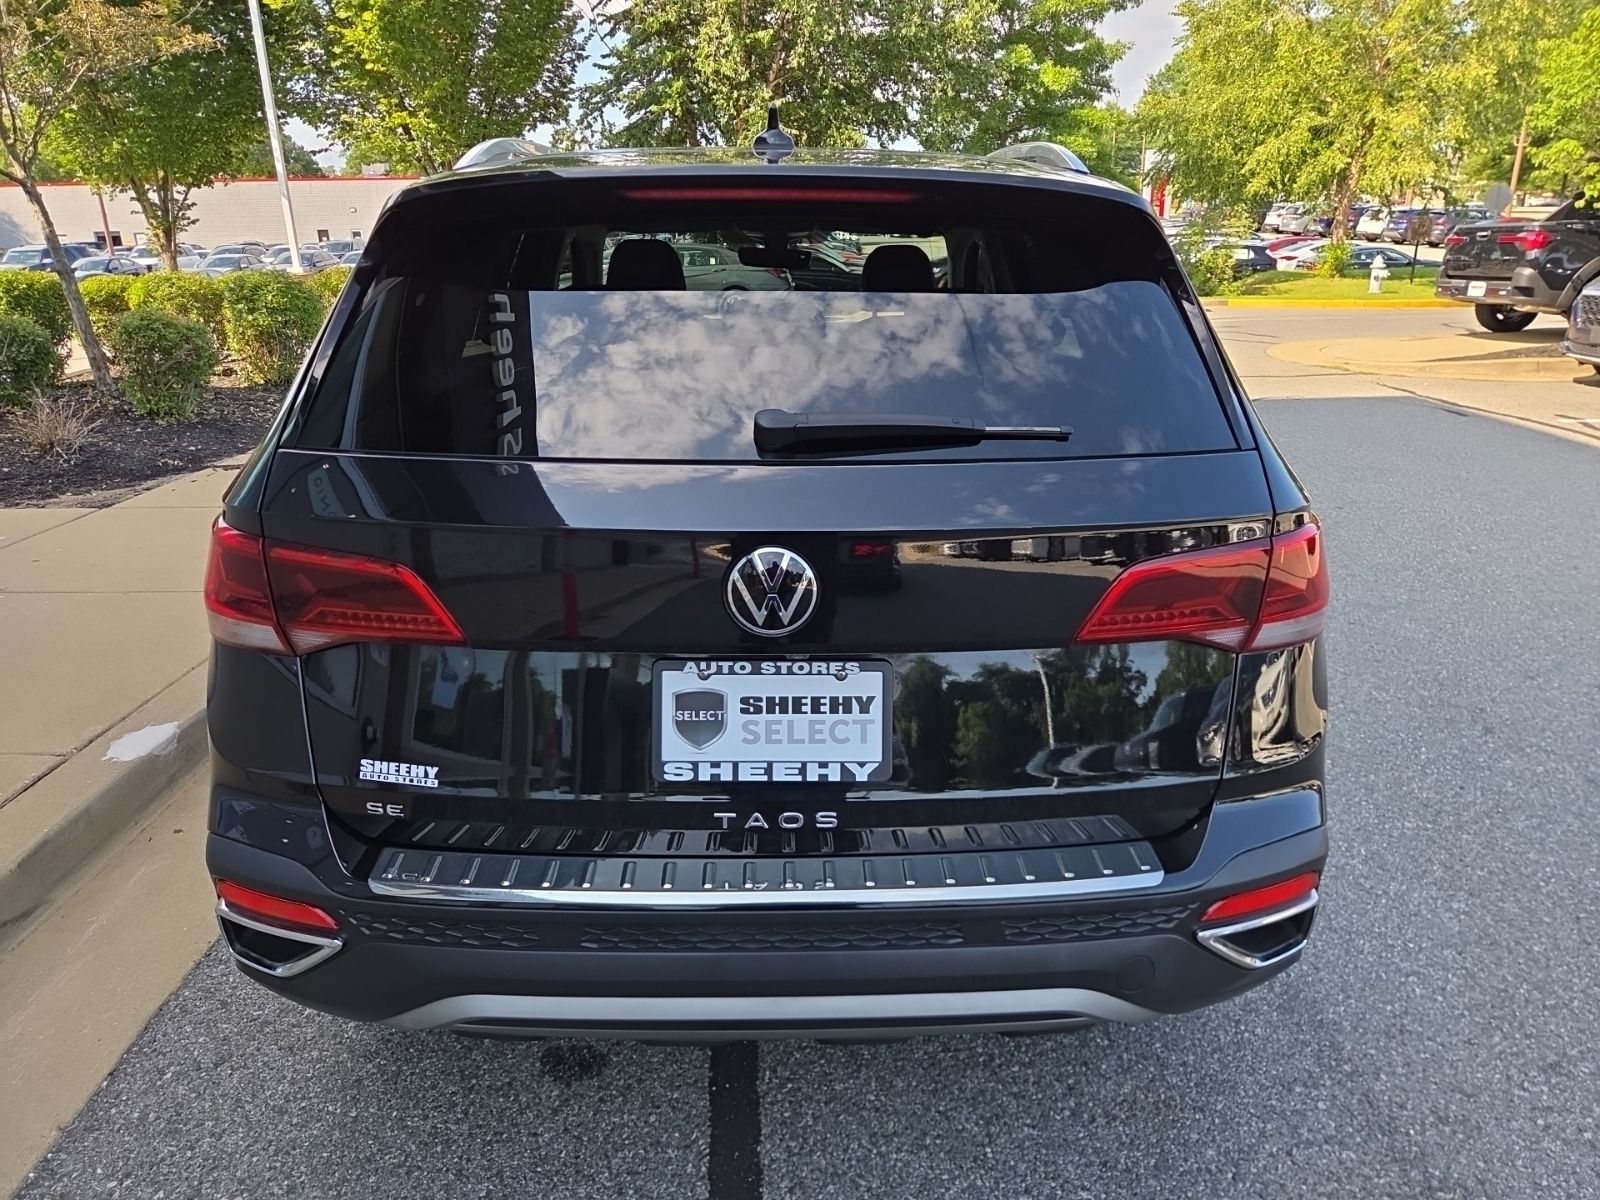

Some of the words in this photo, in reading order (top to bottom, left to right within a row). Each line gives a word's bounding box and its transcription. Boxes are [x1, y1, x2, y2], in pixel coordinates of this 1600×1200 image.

[682, 661, 752, 675] AUTO
[760, 661, 861, 676] STORES
[739, 696, 876, 715] SHEEHY
[675, 710, 725, 721] SELECT
[741, 719, 875, 745] SELECT
[360, 759, 439, 779] SHEEHY
[663, 762, 880, 781] SHEEHY
[362, 772, 389, 781] AUTO
[394, 776, 436, 786] STORES
[366, 802, 404, 817] SE
[713, 811, 839, 829] TAOS
